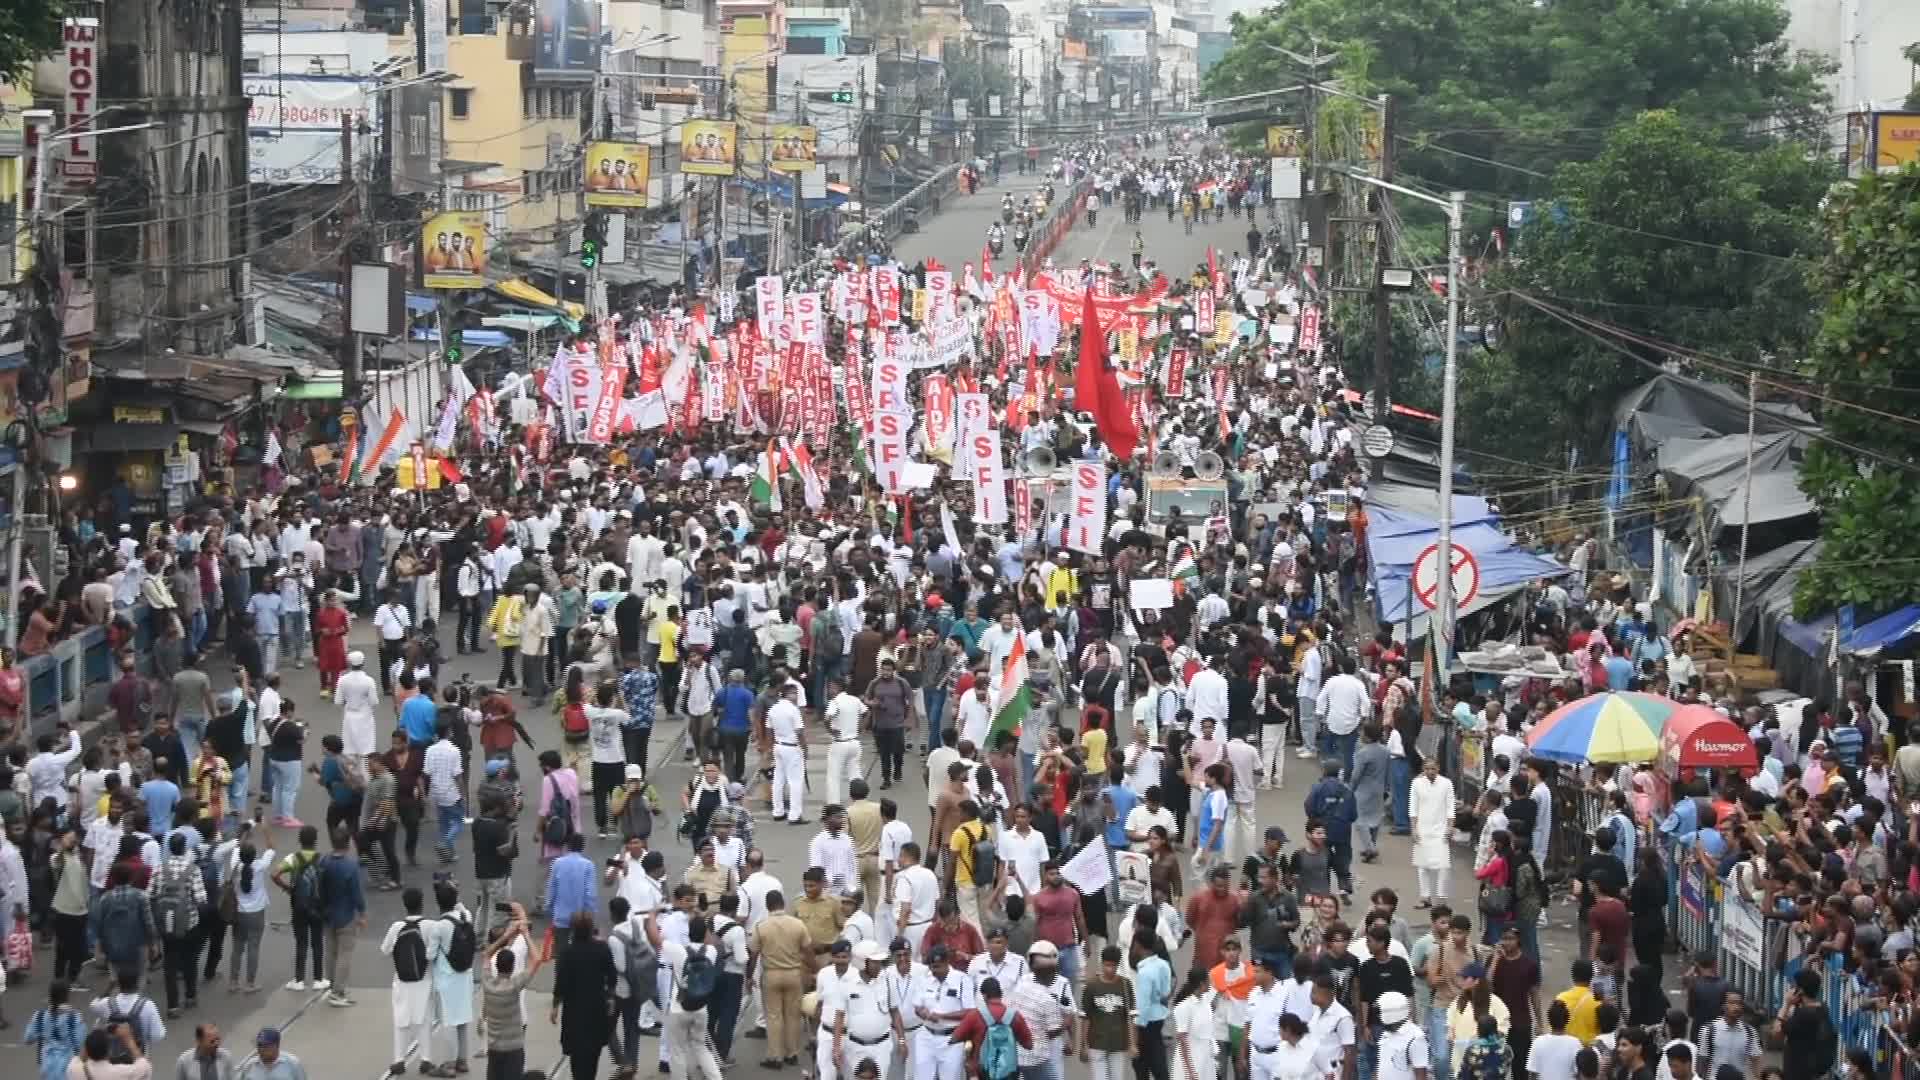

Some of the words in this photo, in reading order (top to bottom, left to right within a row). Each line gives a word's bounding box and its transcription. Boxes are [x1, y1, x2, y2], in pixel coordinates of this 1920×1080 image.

[64, 26, 95, 42] RAJ
[69, 47, 92, 157] HOTEL
[281, 106, 329, 122] 98046
[1199, 291, 1211, 328] AISA
[1303, 307, 1316, 346] AISA
[1172, 353, 1182, 392] PDSF
[593, 369, 620, 437] AIDSO
[802, 386, 816, 430] AISA
[879, 414, 900, 490] SFI
[973, 435, 993, 519] SFI
[1017, 480, 1027, 530] AISA
[1078, 466, 1099, 547] SFI
